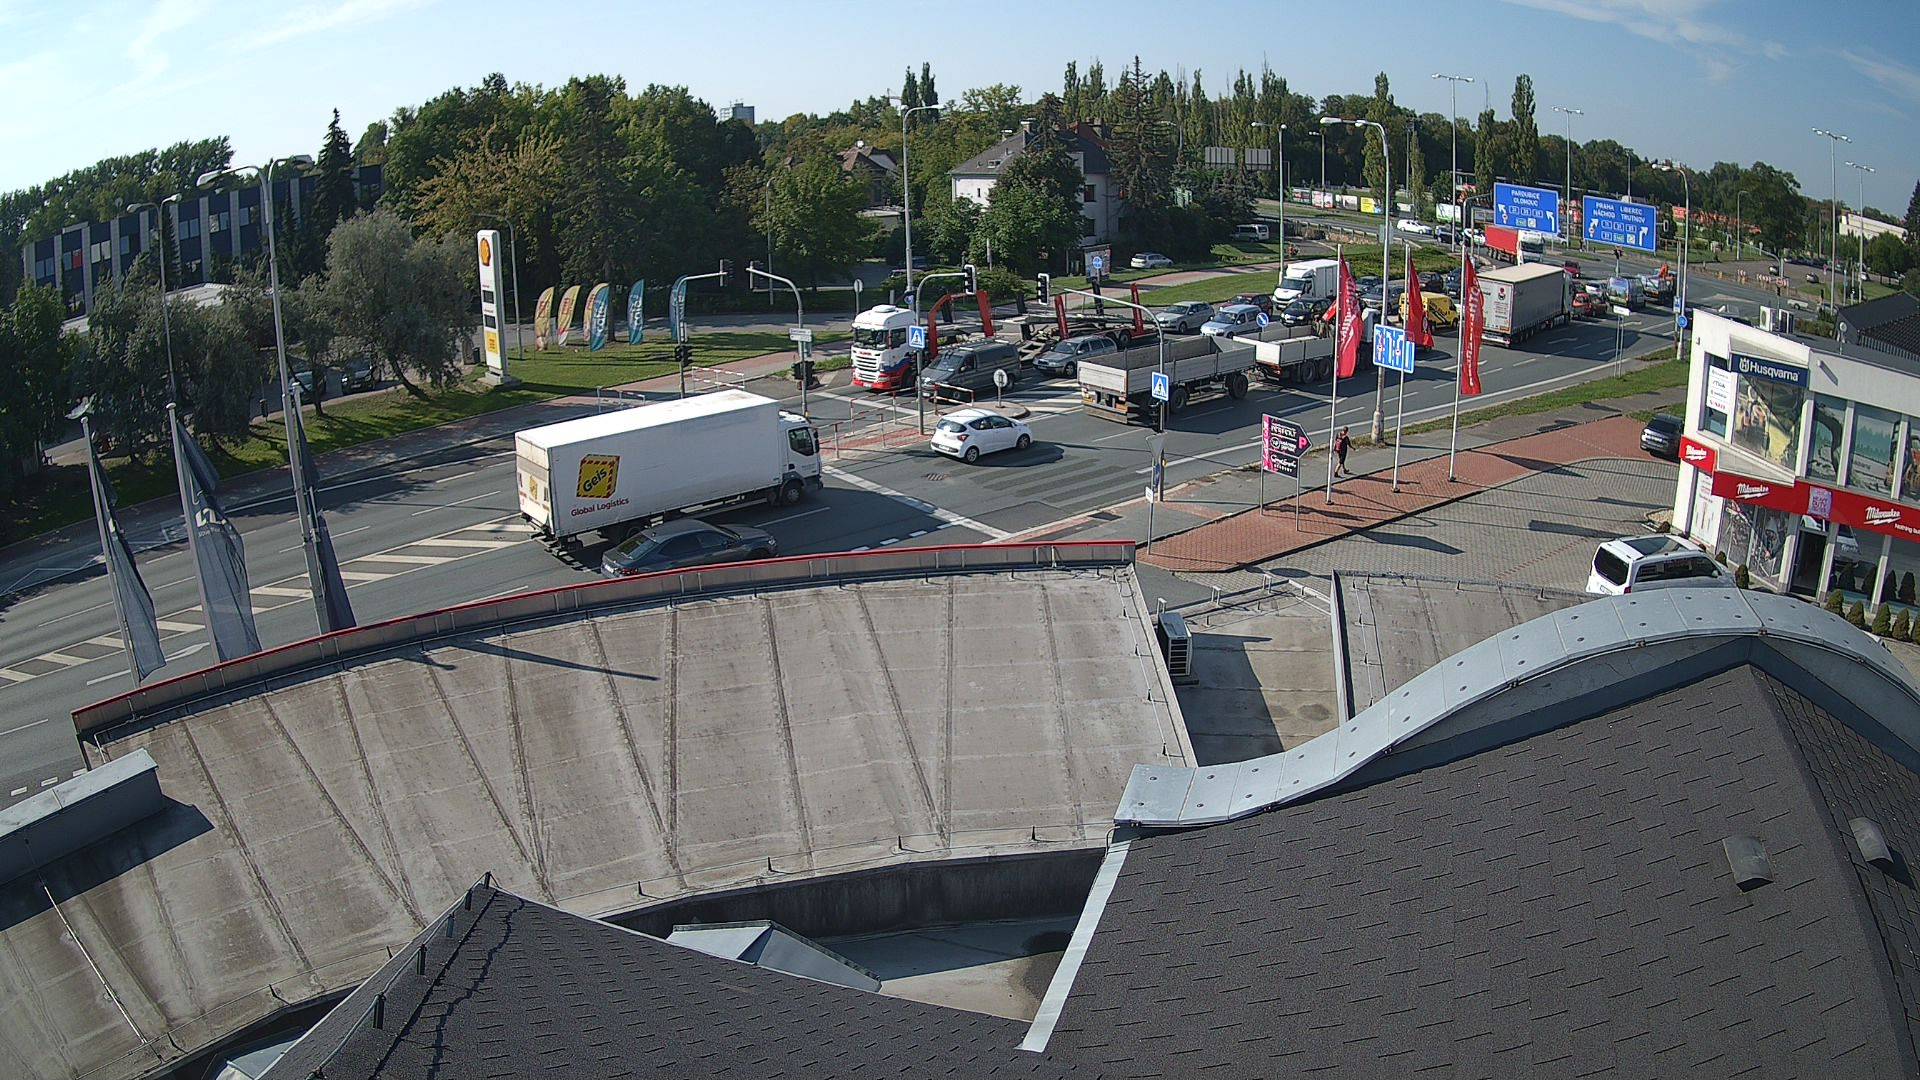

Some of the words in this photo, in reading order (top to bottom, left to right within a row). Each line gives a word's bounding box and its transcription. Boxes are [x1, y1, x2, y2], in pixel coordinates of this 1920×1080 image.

[1513, 197, 1539, 207] OLOMOUC
[1596, 202, 1615, 211] PRAHA
[1620, 206, 1643, 215] LIBEREC
[1621, 213, 1646, 224] TRUTNOV
[1750, 360, 1799, 382] Husqvarna
[1299, 436, 1308, 449] P
[582, 467, 608, 493] Geis
[1736, 483, 1769, 495] Milwaukee
[570, 504, 595, 517] Global
[597, 497, 630, 511] Logistics
[1865, 506, 1901, 520] Milwaukee
